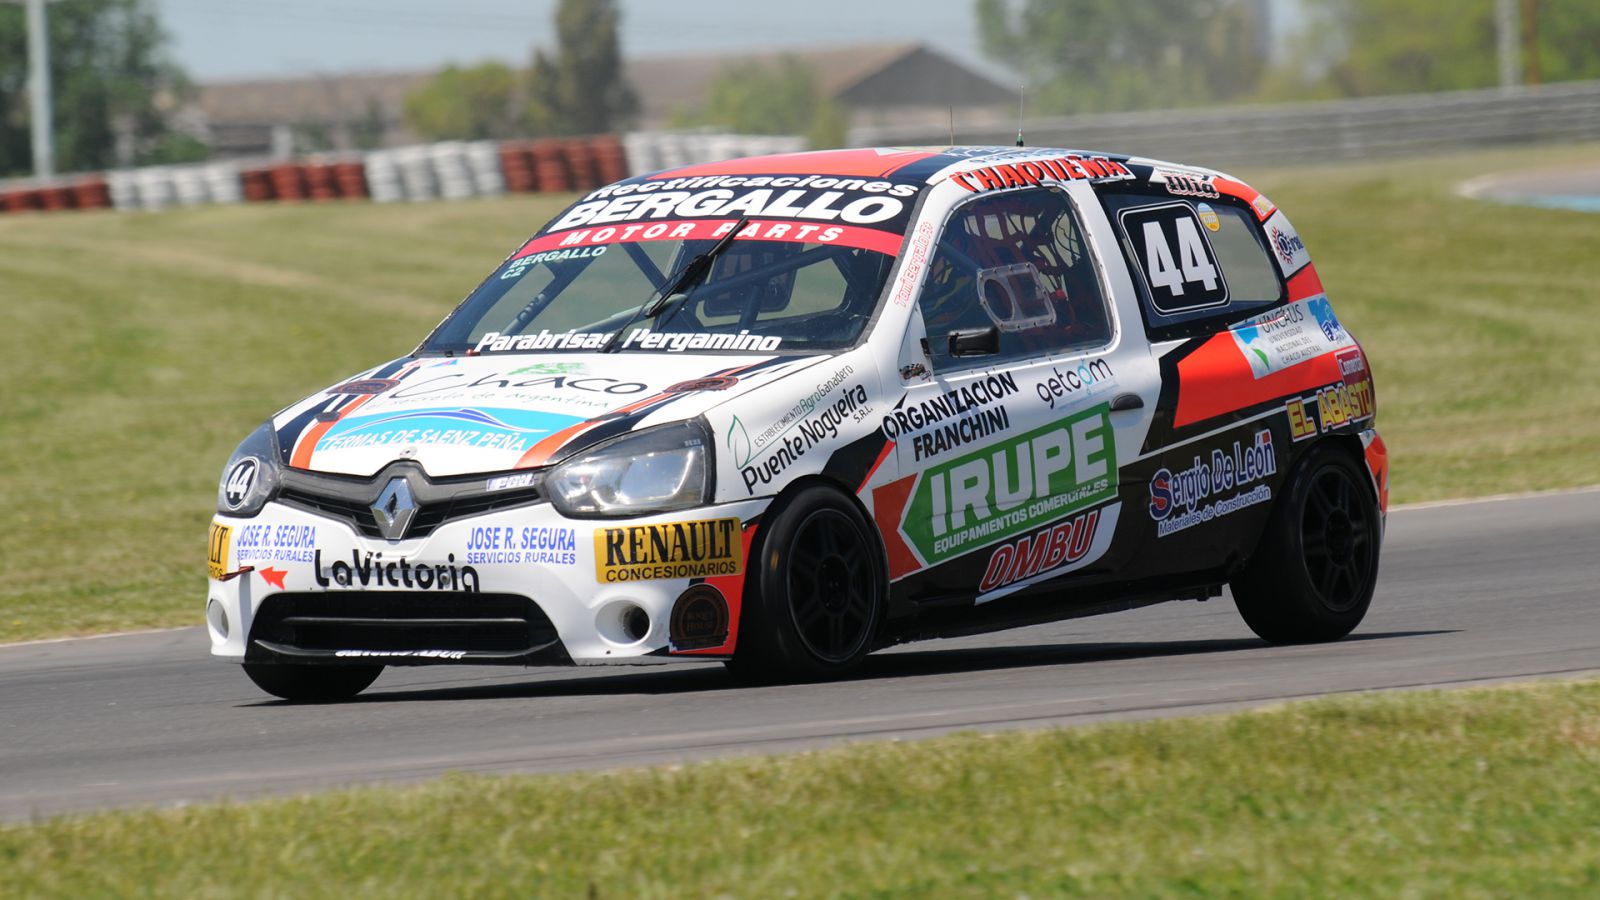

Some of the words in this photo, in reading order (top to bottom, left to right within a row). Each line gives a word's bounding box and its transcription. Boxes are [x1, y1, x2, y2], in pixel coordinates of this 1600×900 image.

[583, 174, 919, 202] Rectificaciones
[547, 189, 903, 233] BERGALLO
[559, 223, 696, 247] MOTOR
[712, 222, 844, 242] PARTS
[500, 266, 526, 280] C2
[509, 246, 607, 270] BERGALLO
[1142, 216, 1218, 296] 44
[621, 328, 782, 352] Pergamino
[1036, 357, 1114, 410] getcom
[1285, 396, 1318, 443] EL
[1316, 380, 1374, 433] ABASTO
[321, 430, 391, 451] TERMAS
[389, 429, 415, 445] DE
[415, 428, 480, 447] SAENZ
[474, 432, 528, 452] PEÑA
[740, 436, 805, 496] Puente
[798, 383, 868, 450] Nogueira
[912, 404, 1010, 462] FRANCHINI
[226, 464, 255, 500] 44
[930, 412, 1108, 538] IRUPE
[1149, 455, 1211, 521] Sergio
[1211, 448, 1235, 494] De
[1233, 428, 1277, 486] León
[934, 508, 1028, 554] EQUIPAMIENTOS
[1028, 479, 1109, 518] COMERCIALES
[1157, 509, 1202, 538] Materiales
[1202, 503, 1215, 522] de
[237, 525, 260, 547] JOSE
[274, 525, 316, 549] SEGURA
[467, 527, 501, 550] JOSE
[504, 527, 516, 550] R.
[521, 527, 576, 551] SEGURA
[605, 519, 735, 567] RENAULT
[979, 509, 1099, 593] OMBU
[237, 549, 272, 561] SERVICIOS
[274, 550, 314, 563] RURALES
[467, 551, 522, 565] SERVICIOS
[524, 551, 576, 565] RURALES
[606, 560, 737, 583] CONCESIONARIOS
